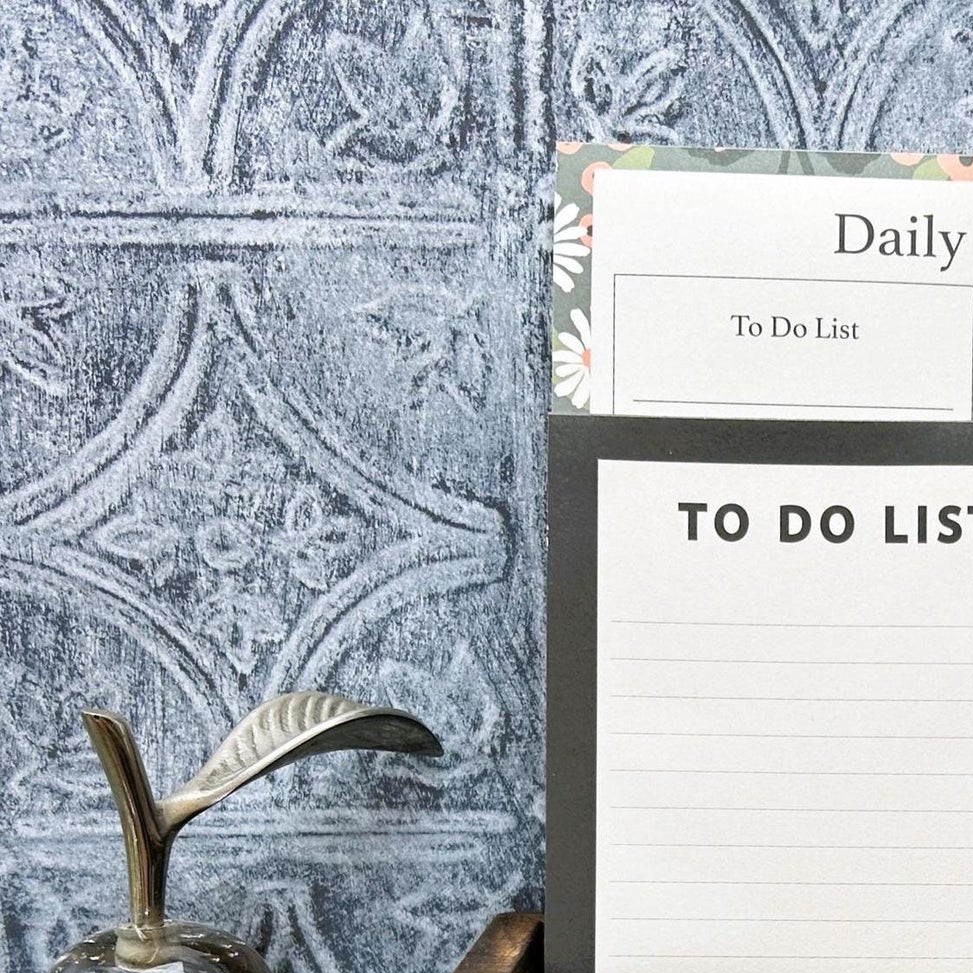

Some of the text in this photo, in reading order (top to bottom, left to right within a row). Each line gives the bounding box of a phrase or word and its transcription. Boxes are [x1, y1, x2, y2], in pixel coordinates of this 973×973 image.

[835, 214, 966, 271] Daily
[731, 315, 858, 339] To Do List
[678, 503, 749, 542] TO
[780, 505, 854, 543] DO
